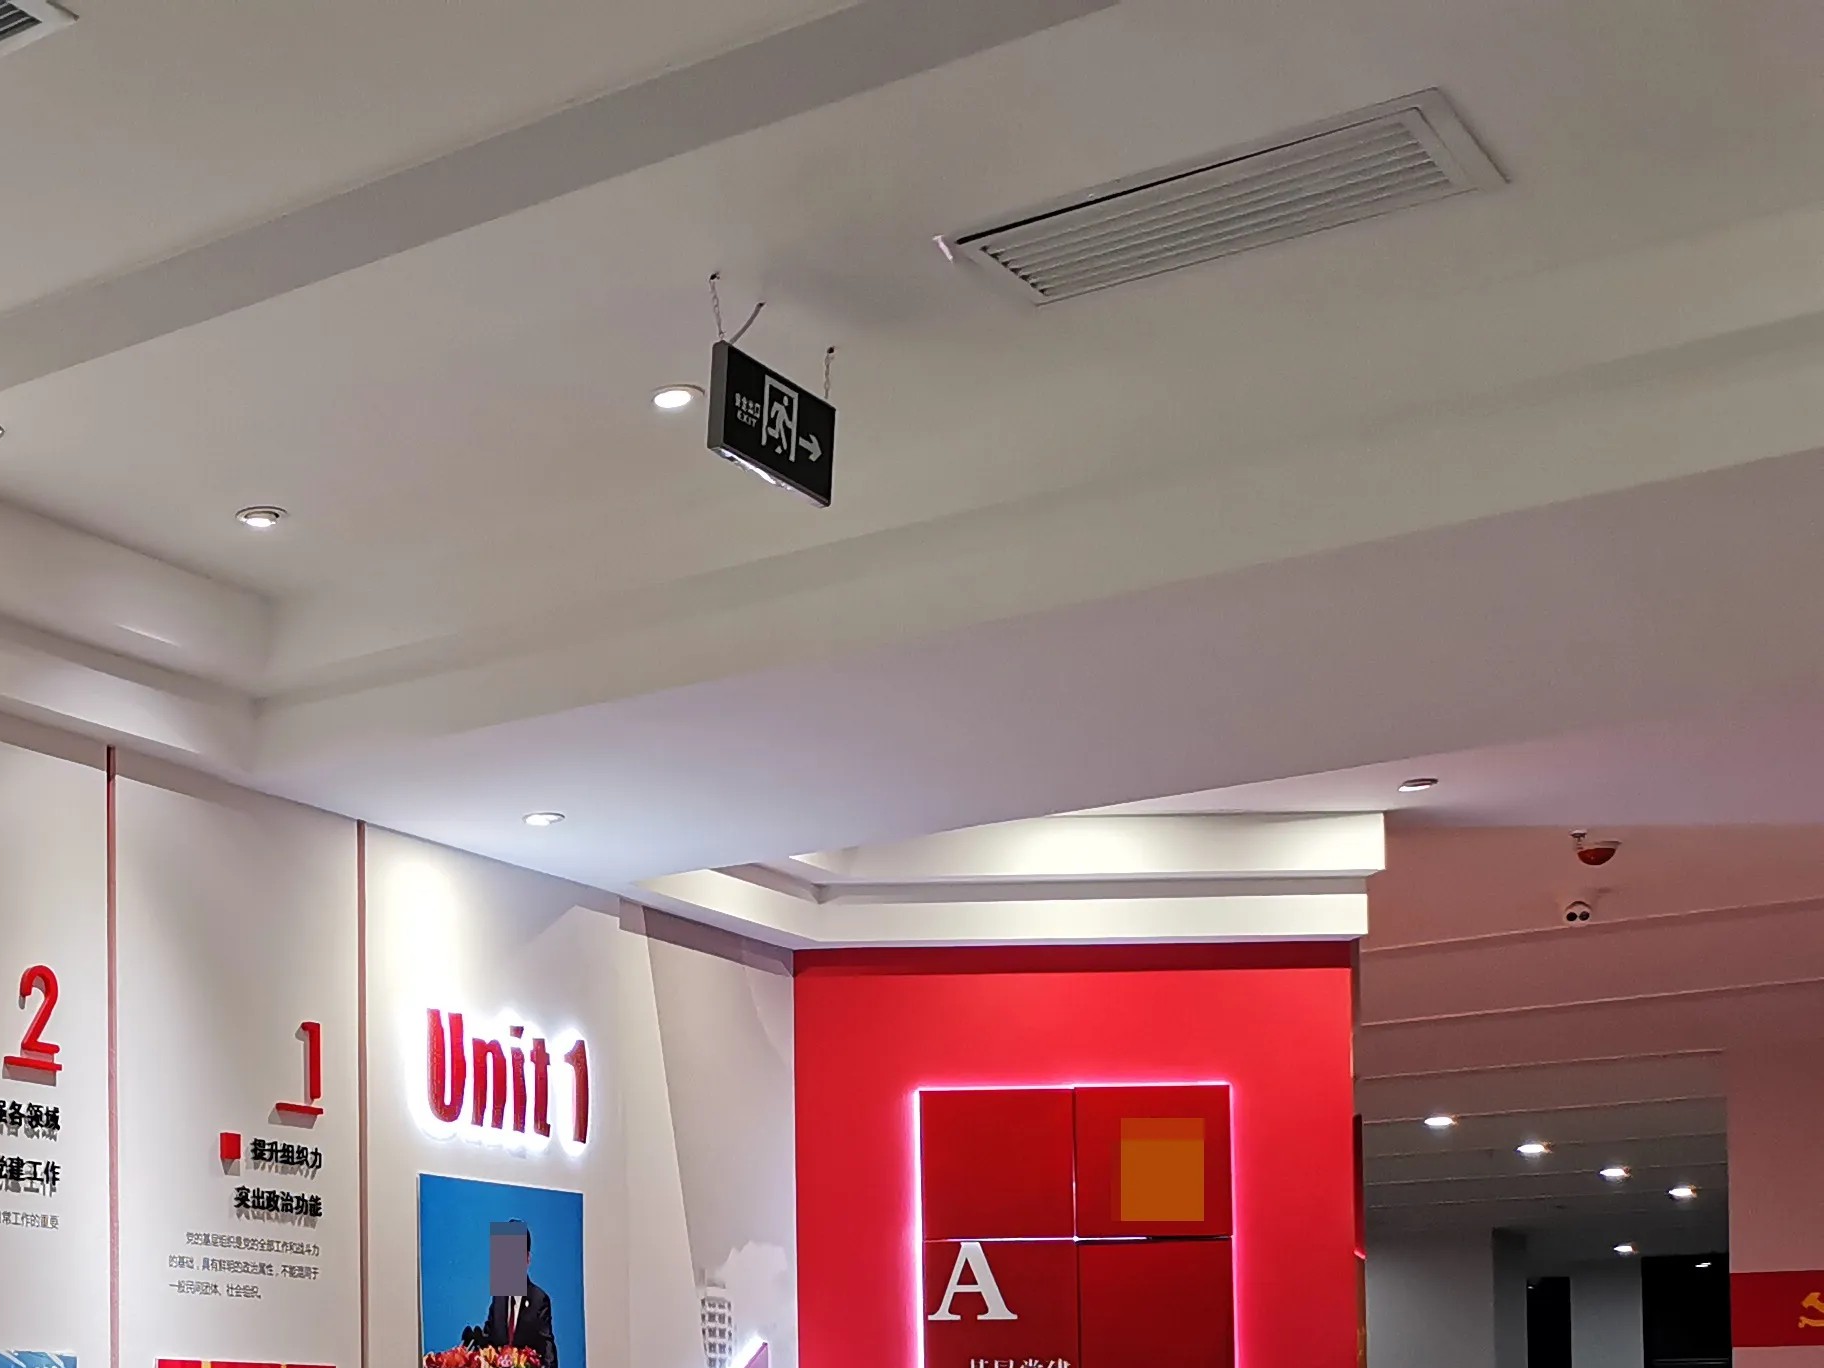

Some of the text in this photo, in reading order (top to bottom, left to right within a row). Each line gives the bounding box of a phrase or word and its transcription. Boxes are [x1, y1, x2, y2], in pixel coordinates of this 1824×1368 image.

[20, 965, 60, 1053] 2
[301, 1021, 321, 1099] 1
[251, 1138, 323, 1170] 提升组织力
[234, 1185, 323, 1217] 突出政治功能
[928, 1242, 1018, 1321] A
